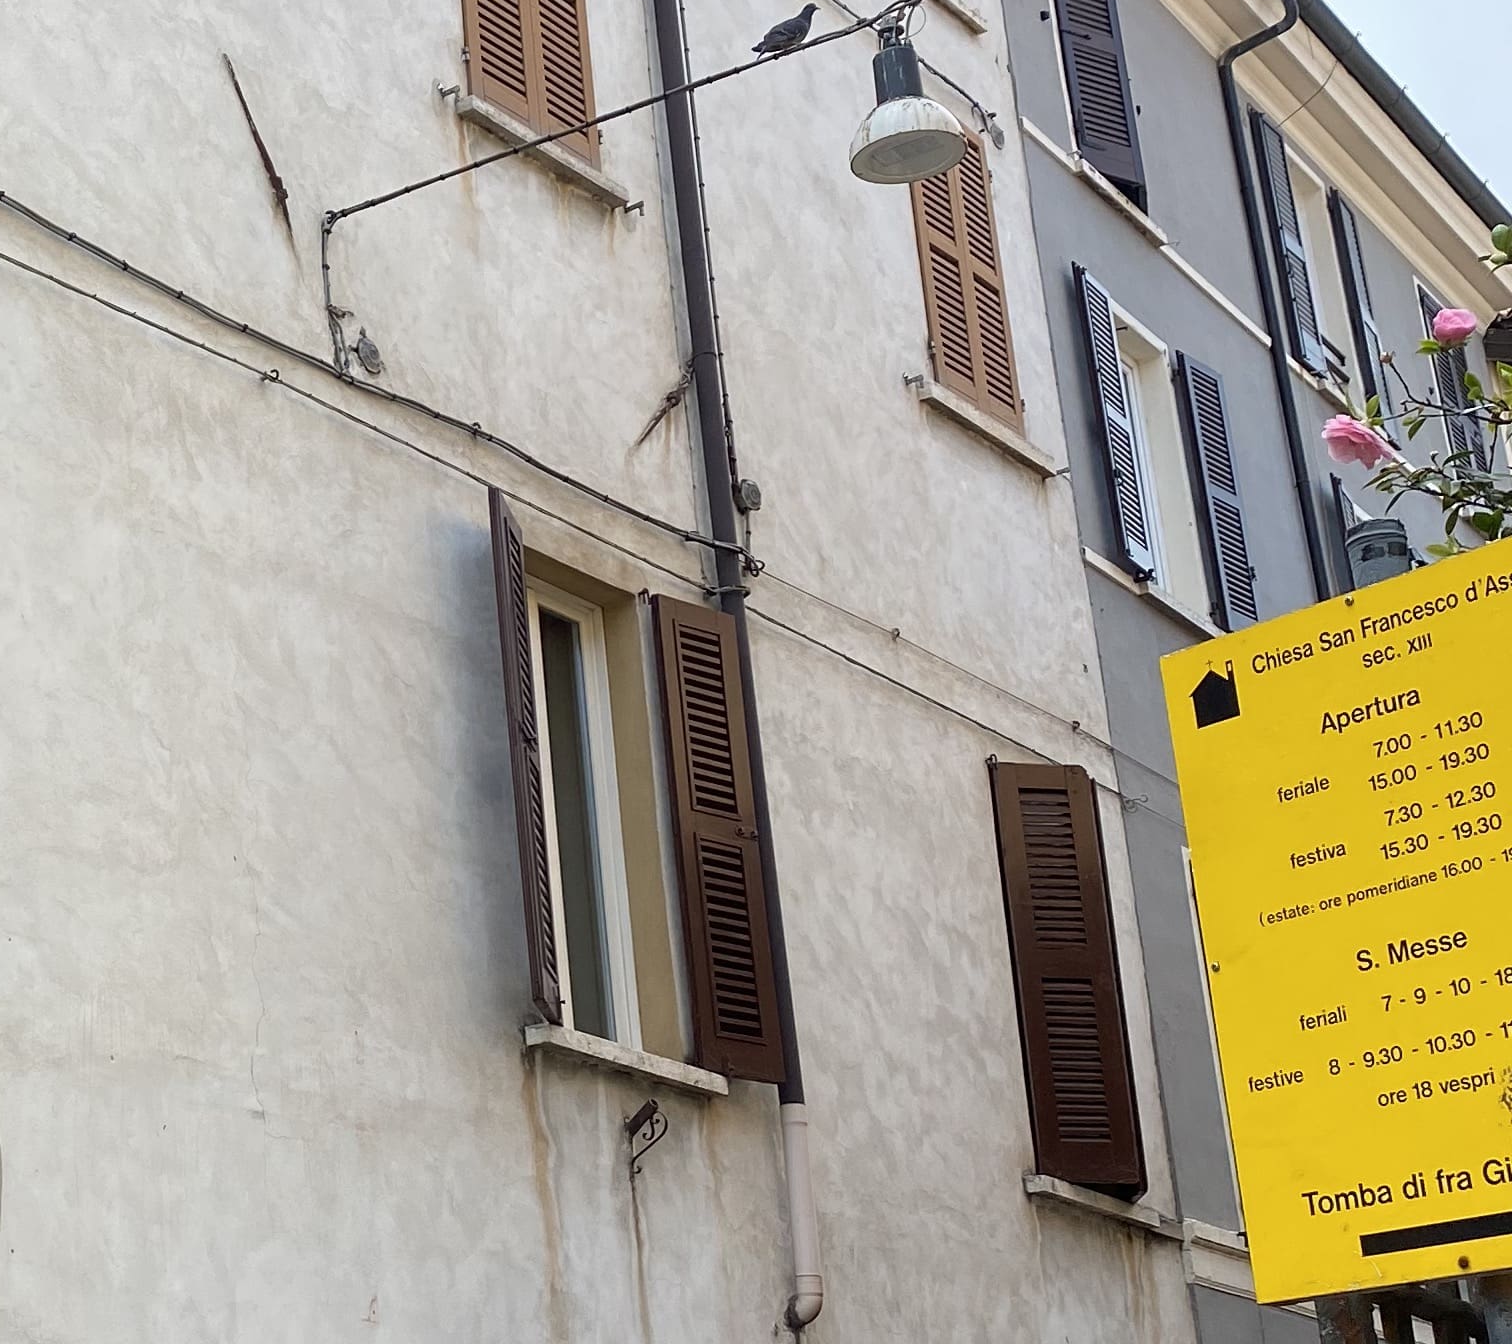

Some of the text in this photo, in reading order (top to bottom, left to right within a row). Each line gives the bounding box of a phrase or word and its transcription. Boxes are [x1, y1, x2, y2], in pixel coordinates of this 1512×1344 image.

[1253, 573, 1512, 673] Chiesa San Francesco d'As
[1363, 633, 1432, 668] sec. XIII
[1322, 690, 1420, 734] Apertura
[1373, 734, 1411, 757] 7.00
[1434, 712, 1482, 738] 11.30
[1278, 777, 1329, 802] feriale
[1368, 765, 1416, 791] 15.00
[1439, 744, 1489, 770] 19.30
[1384, 803, 1422, 826] 7.30
[1446, 782, 1495, 808] 12.30
[1290, 844, 1346, 868] festiva
[1380, 834, 1428, 859] 15.30
[1452, 814, 1501, 840] 19.30
[1319, 897, 1341, 910] ore
[1347, 872, 1437, 906] pomeridiane
[1441, 857, 1482, 878] 16.00
[1357, 932, 1467, 971] S. Messe
[1300, 1006, 1346, 1030] feriali
[1382, 995, 1391, 1011] 7
[1414, 988, 1426, 1004] 9
[1449, 978, 1470, 996] 10
[1495, 967, 1512, 985] 18
[1249, 1070, 1303, 1092] festive
[1329, 1059, 1340, 1075] 8
[1363, 1046, 1402, 1067] 9.30
[1426, 1030, 1475, 1054] 10.30
[1378, 1068, 1495, 1106] ore 18 vespri
[1302, 1157, 1512, 1215] Tomba di fra Gi
